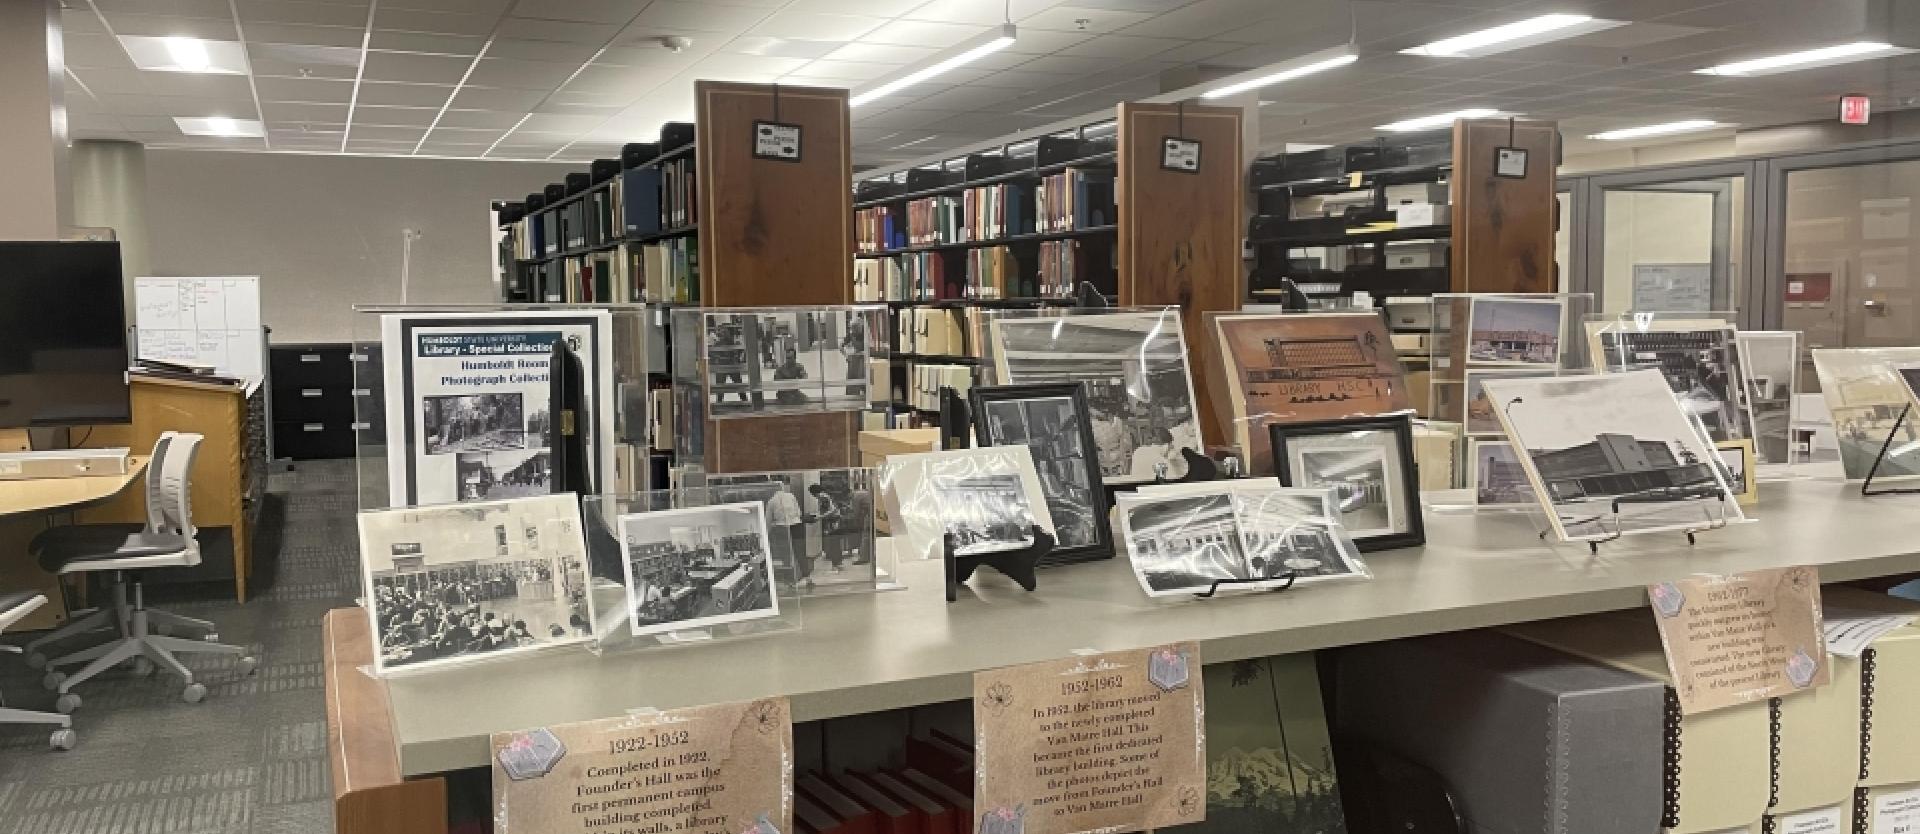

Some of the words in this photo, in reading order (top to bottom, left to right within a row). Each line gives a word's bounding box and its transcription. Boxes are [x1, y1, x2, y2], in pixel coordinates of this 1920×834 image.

[421, 336, 463, 345] HUMBOLDT
[463, 336, 484, 344] STATE
[485, 335, 527, 343] UNIVERSITY
[423, 343, 461, 356] Library
[469, 343, 505, 356] Special
[461, 360, 514, 370] Humboldt
[518, 359, 549, 369] Room
[441, 373, 507, 386] Photograph
[509, 372, 549, 383] Collecti
[1278, 382, 1321, 396] LIBRARY
[1062, 674, 1123, 696] 1952-1962
[1033, 708, 1044, 718] In
[1074, 702, 1090, 713] the
[1091, 698, 1124, 710] library
[1127, 692, 1160, 706] moved
[1040, 724, 1050, 732] to
[1053, 720, 1069, 730] the
[1072, 714, 1101, 728] newly
[1104, 706, 1155, 723] completed
[610, 730, 689, 755] 1922-1952
[1047, 736, 1067, 746] Van
[1070, 732, 1100, 742] Matre
[1128, 722, 1149, 734] This
[1033, 749, 1072, 763] became
[1075, 746, 1090, 757] the
[1093, 742, 1113, 754] first
[1116, 734, 1163, 751] dedicated
[587, 757, 659, 778] Completed
[663, 756, 675, 768] in
[1036, 766, 1069, 778] library
[1120, 752, 1145, 764] Some
[1149, 749, 1160, 760] of
[577, 776, 642, 798] Founder's
[646, 772, 672, 786] Hall
[676, 772, 698, 782] was
[701, 766, 721, 779] the
[1047, 780, 1062, 790] the
[1065, 776, 1100, 790] photos
[1102, 770, 1132, 782] depict
[1134, 764, 1150, 776] the
[572, 802, 599, 814] first
[602, 790, 673, 812] permanent
[677, 784, 725, 799] campus
[1032, 794, 1060, 806] move
[1064, 790, 1089, 802] from
[1092, 780, 1141, 797] Founder's
[1143, 776, 1163, 790] Hall
[1054, 808, 1064, 816] to
[1068, 804, 1087, 814] Van
[1089, 800, 1120, 812] Matre
[584, 812, 642, 828] building
[676, 822, 682, 830] a
[686, 814, 728, 830] library
